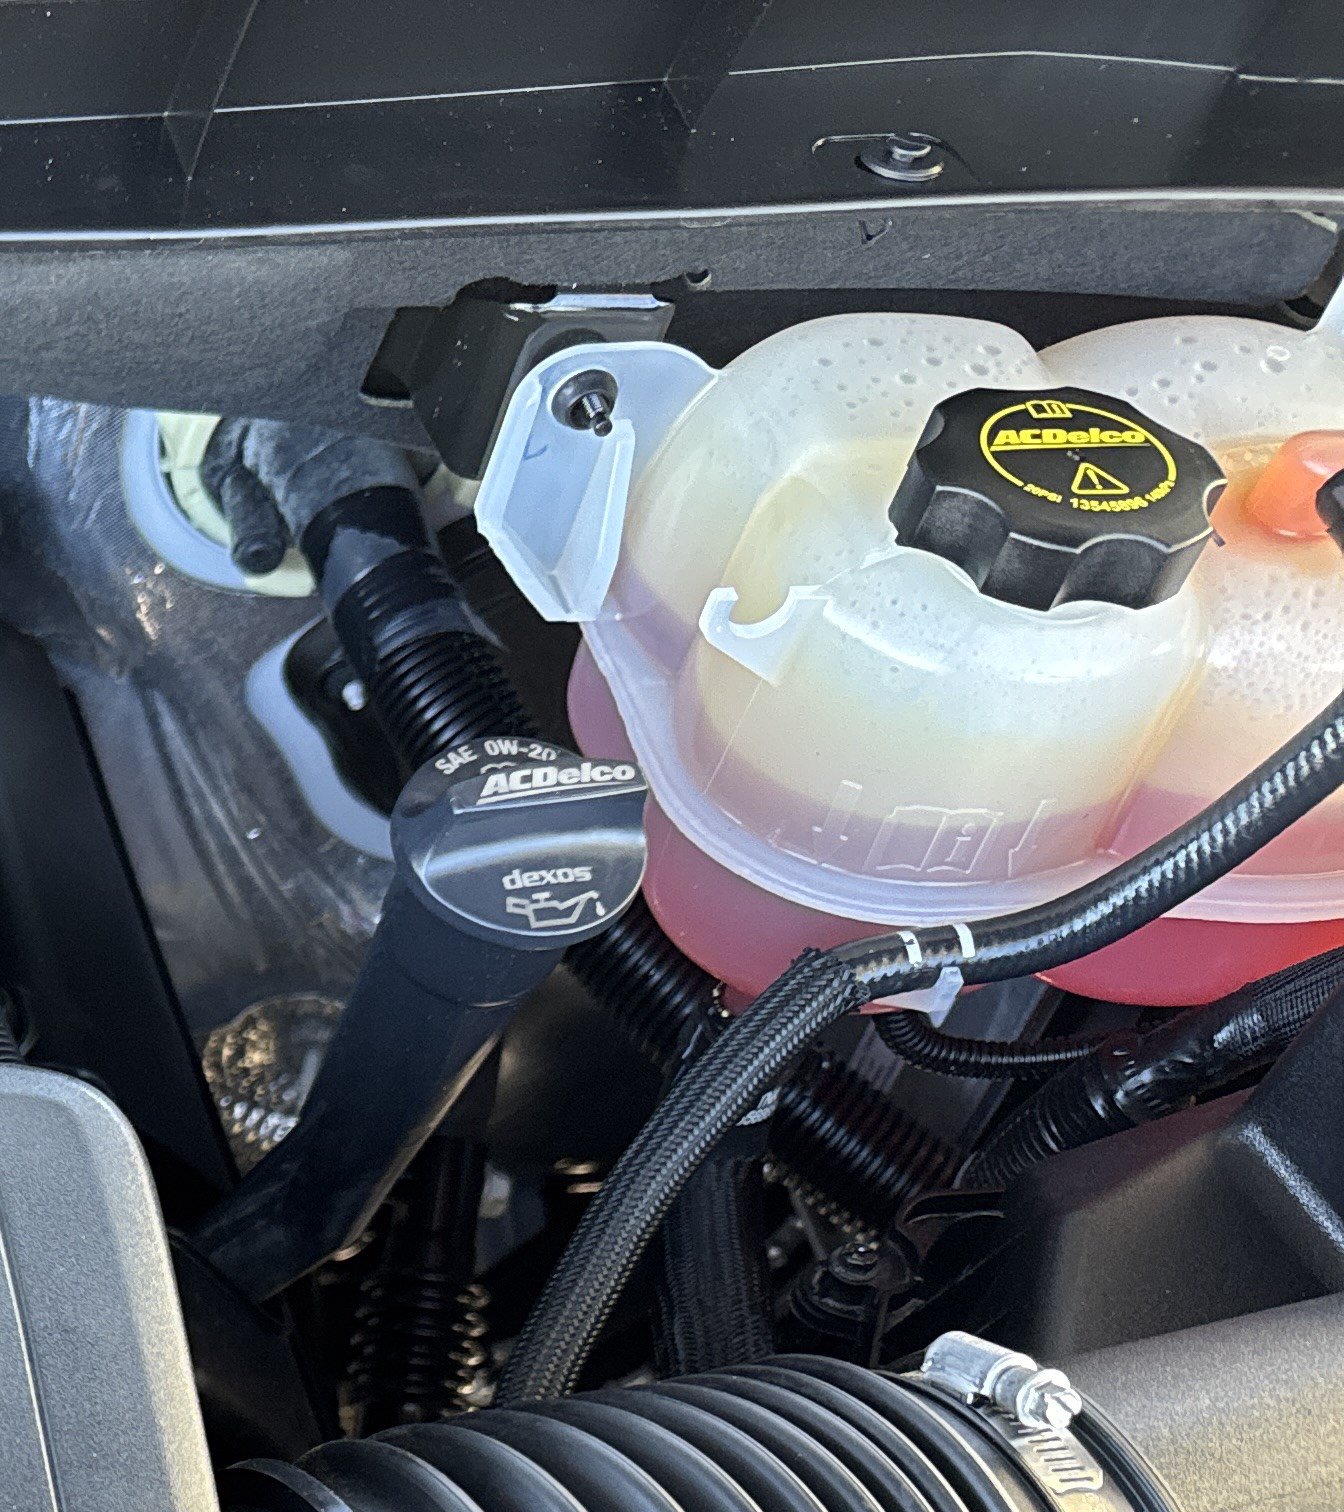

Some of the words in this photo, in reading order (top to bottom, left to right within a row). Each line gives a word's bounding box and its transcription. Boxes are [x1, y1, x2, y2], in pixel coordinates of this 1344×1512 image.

[995, 427, 1146, 445] ACDelco
[434, 744, 478, 775] SAE
[484, 739, 558, 761] 0W-20
[479, 762, 636, 798] ACDelco
[501, 866, 593, 891] dexos
